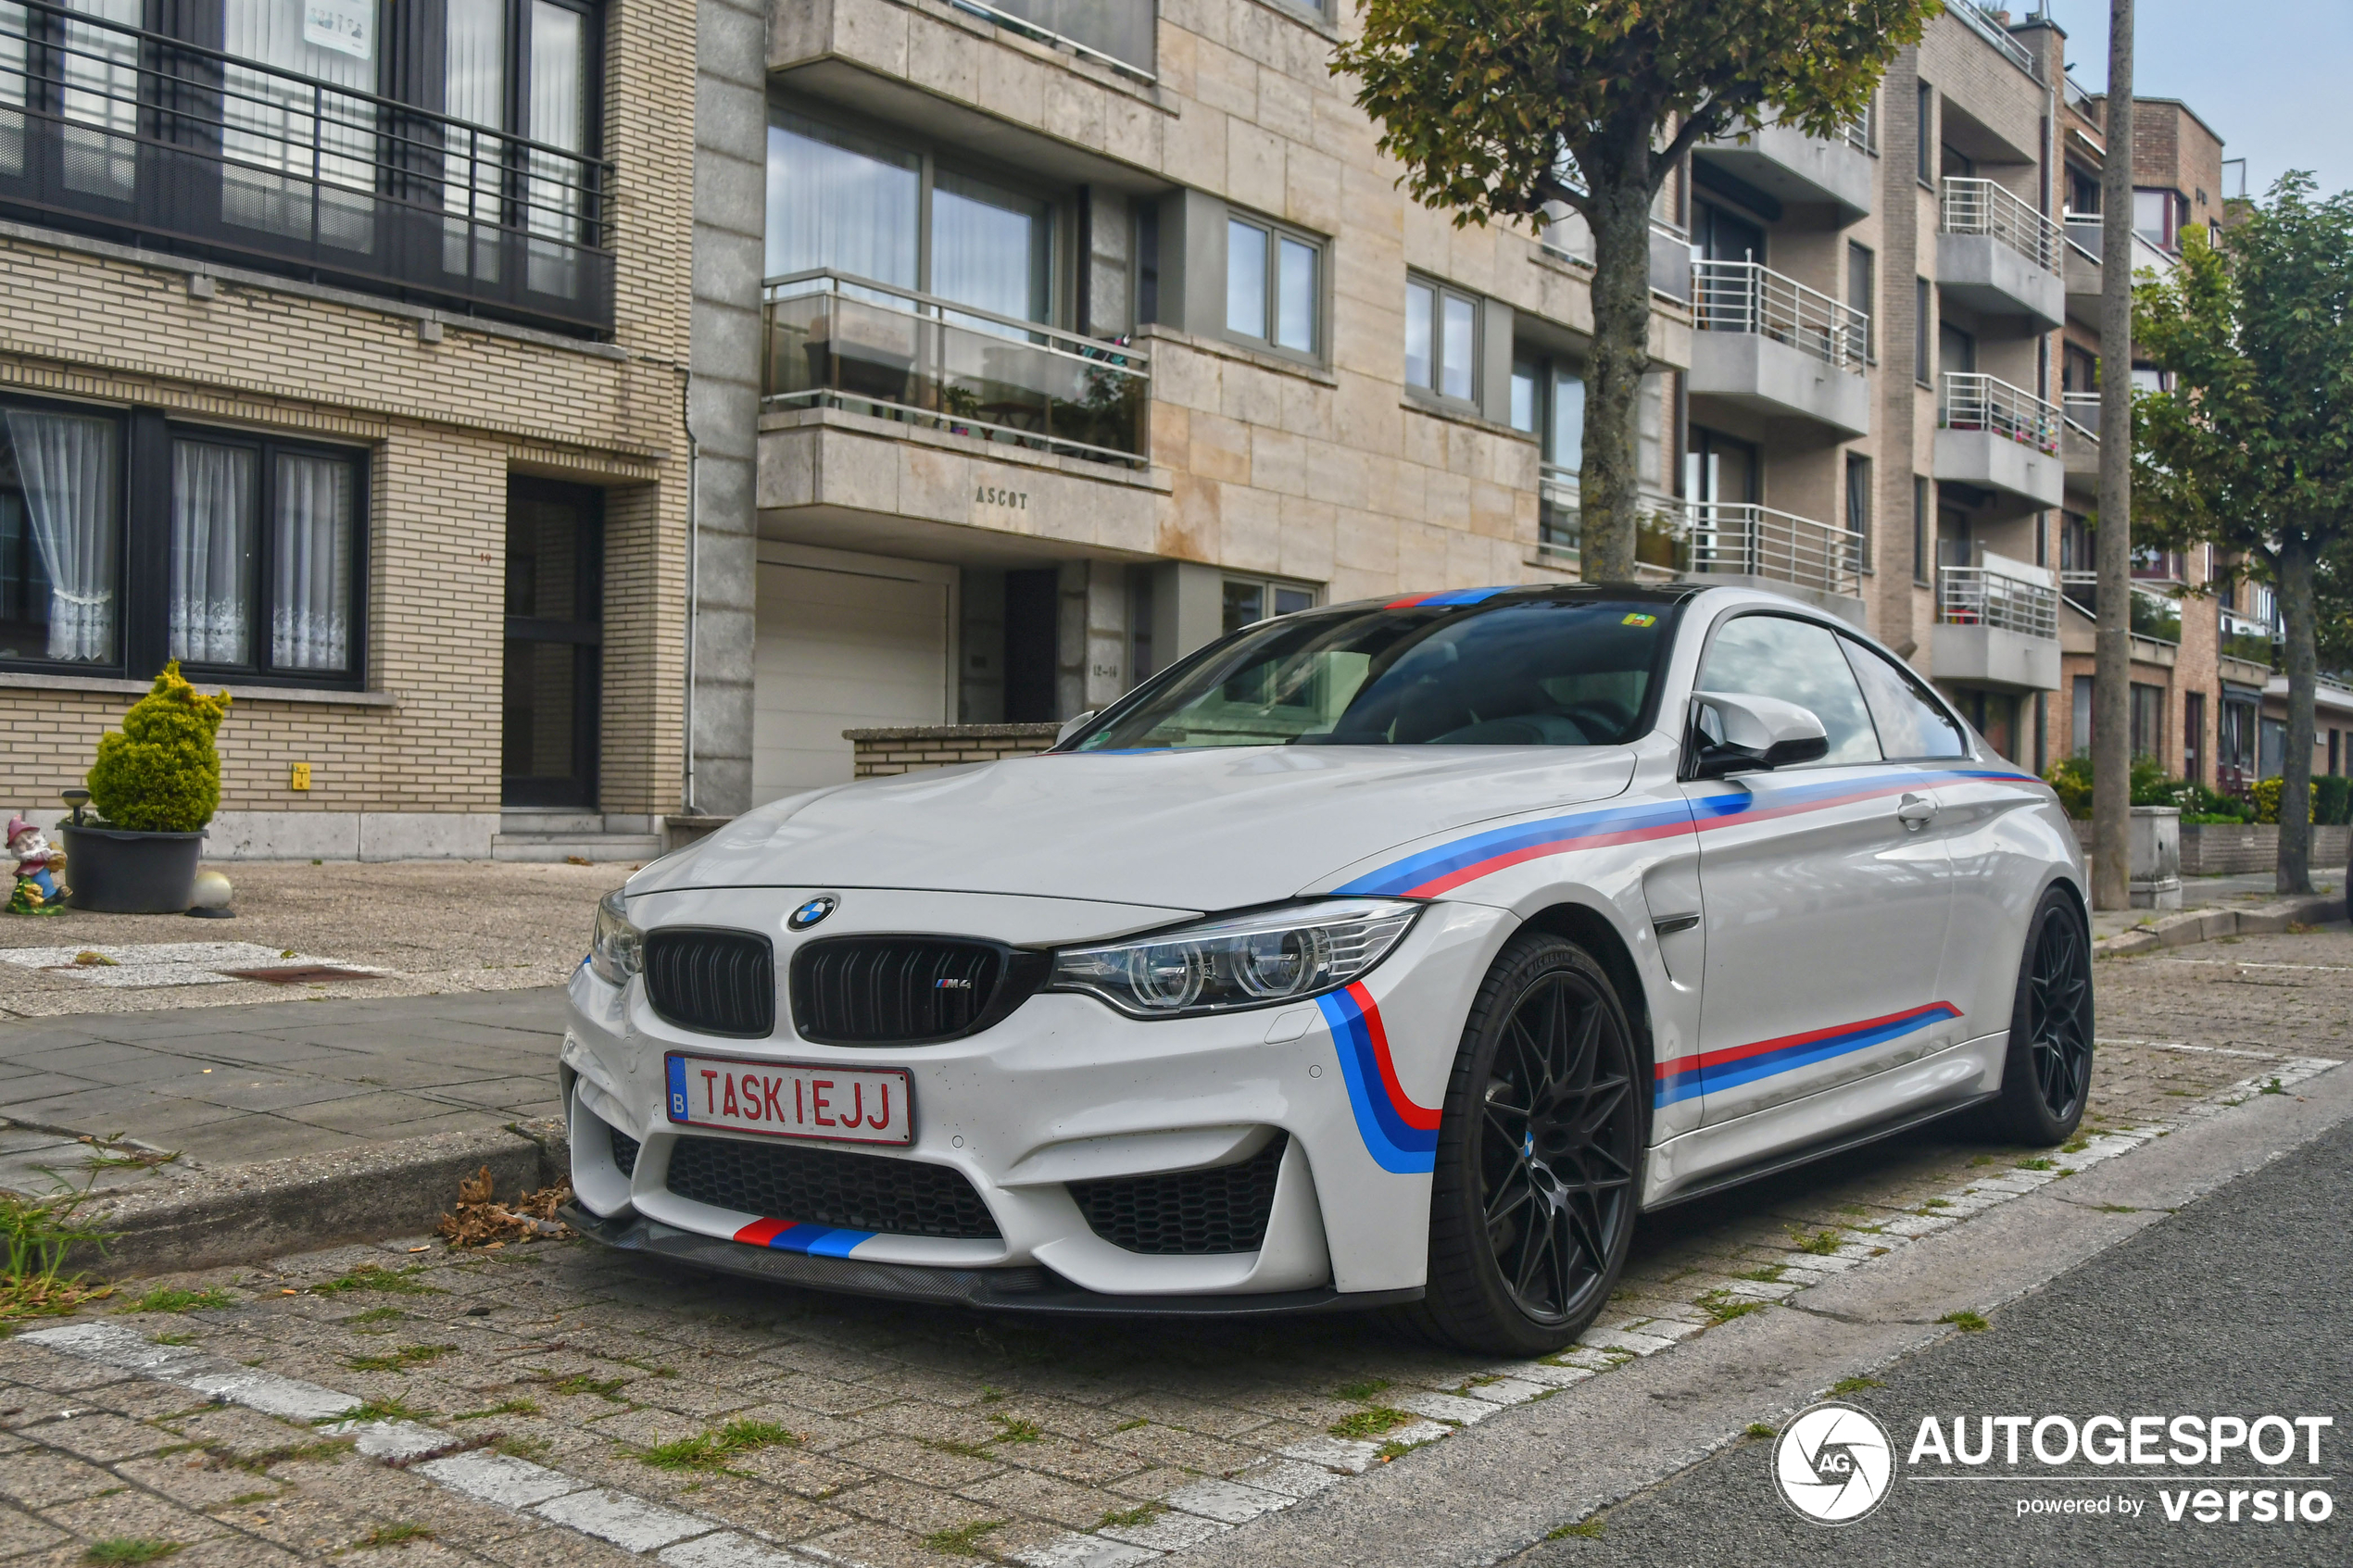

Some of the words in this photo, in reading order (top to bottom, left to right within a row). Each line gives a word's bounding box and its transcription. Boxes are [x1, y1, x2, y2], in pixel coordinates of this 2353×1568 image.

[975, 486, 1027, 509] ASCOT
[1527, 951, 1571, 976] MICHELIN
[936, 978, 972, 989] M4
[673, 1093, 685, 1114] B
[700, 1069, 890, 1130] TASKIEJJ
